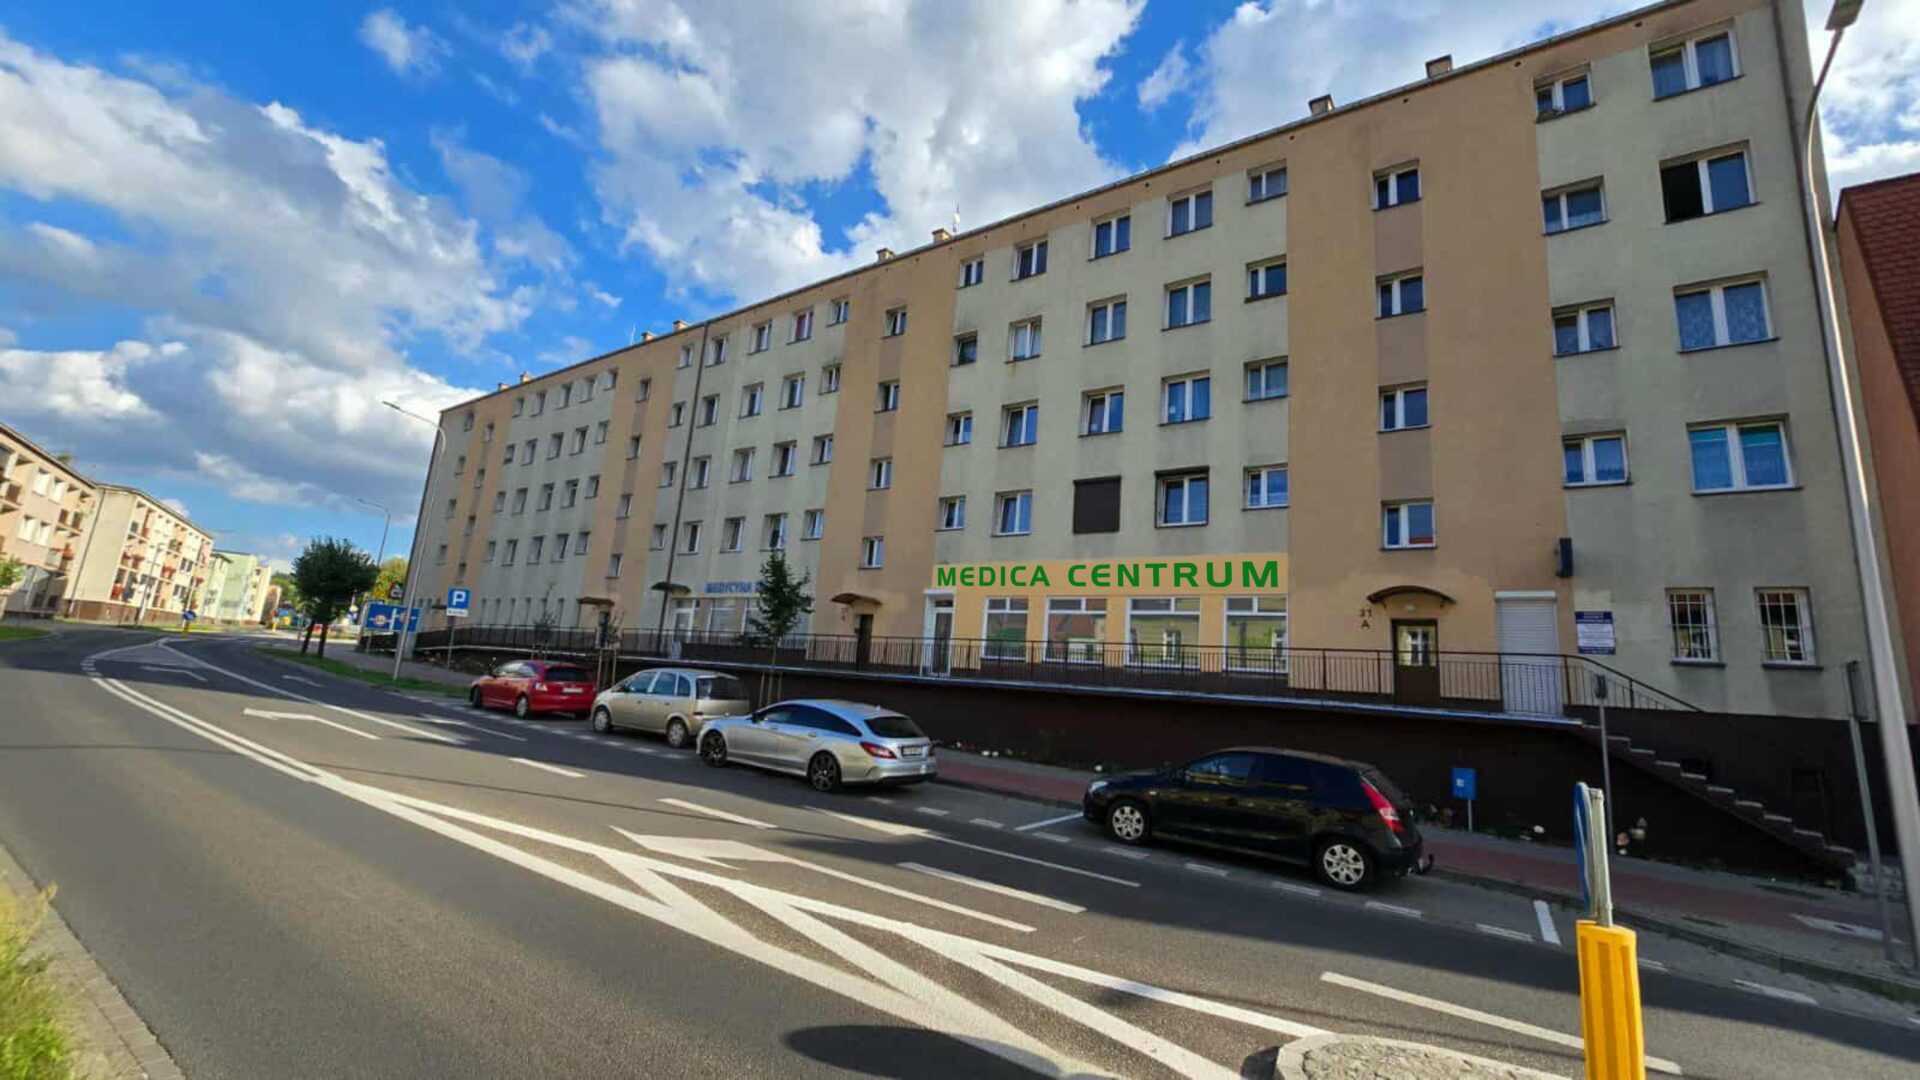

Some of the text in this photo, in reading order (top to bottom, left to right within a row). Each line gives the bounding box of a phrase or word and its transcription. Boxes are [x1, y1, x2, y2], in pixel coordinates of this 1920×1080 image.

[938, 561, 1278, 587] MEDICA CENTRUM
[452, 591, 466, 605] P
